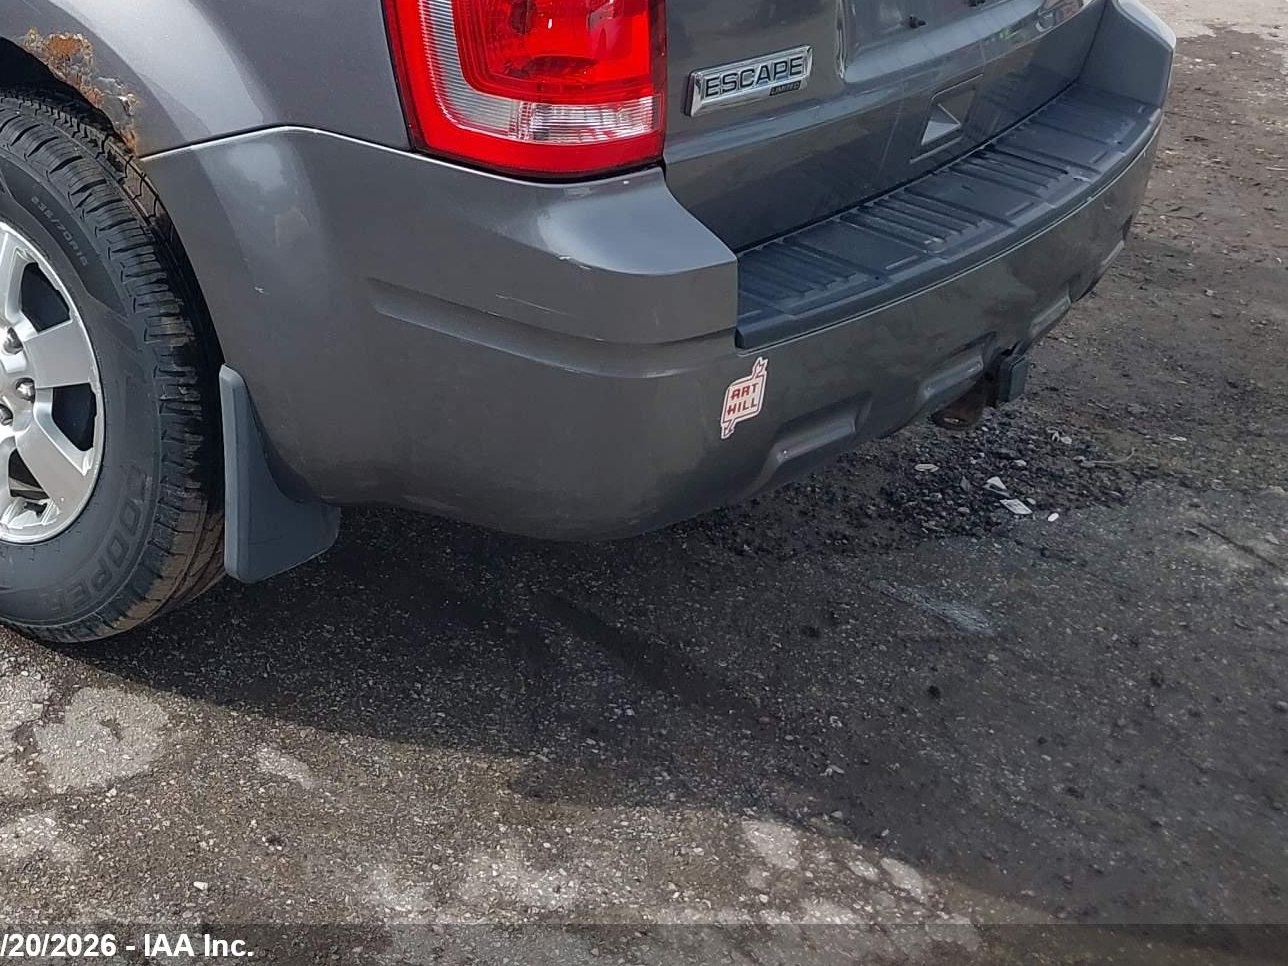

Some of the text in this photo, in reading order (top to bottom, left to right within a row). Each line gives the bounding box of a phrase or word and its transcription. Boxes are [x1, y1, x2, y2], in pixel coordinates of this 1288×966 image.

[705, 56, 803, 97] ESCAPE
[731, 382, 759, 401] ART
[727, 397, 757, 416] HILL
